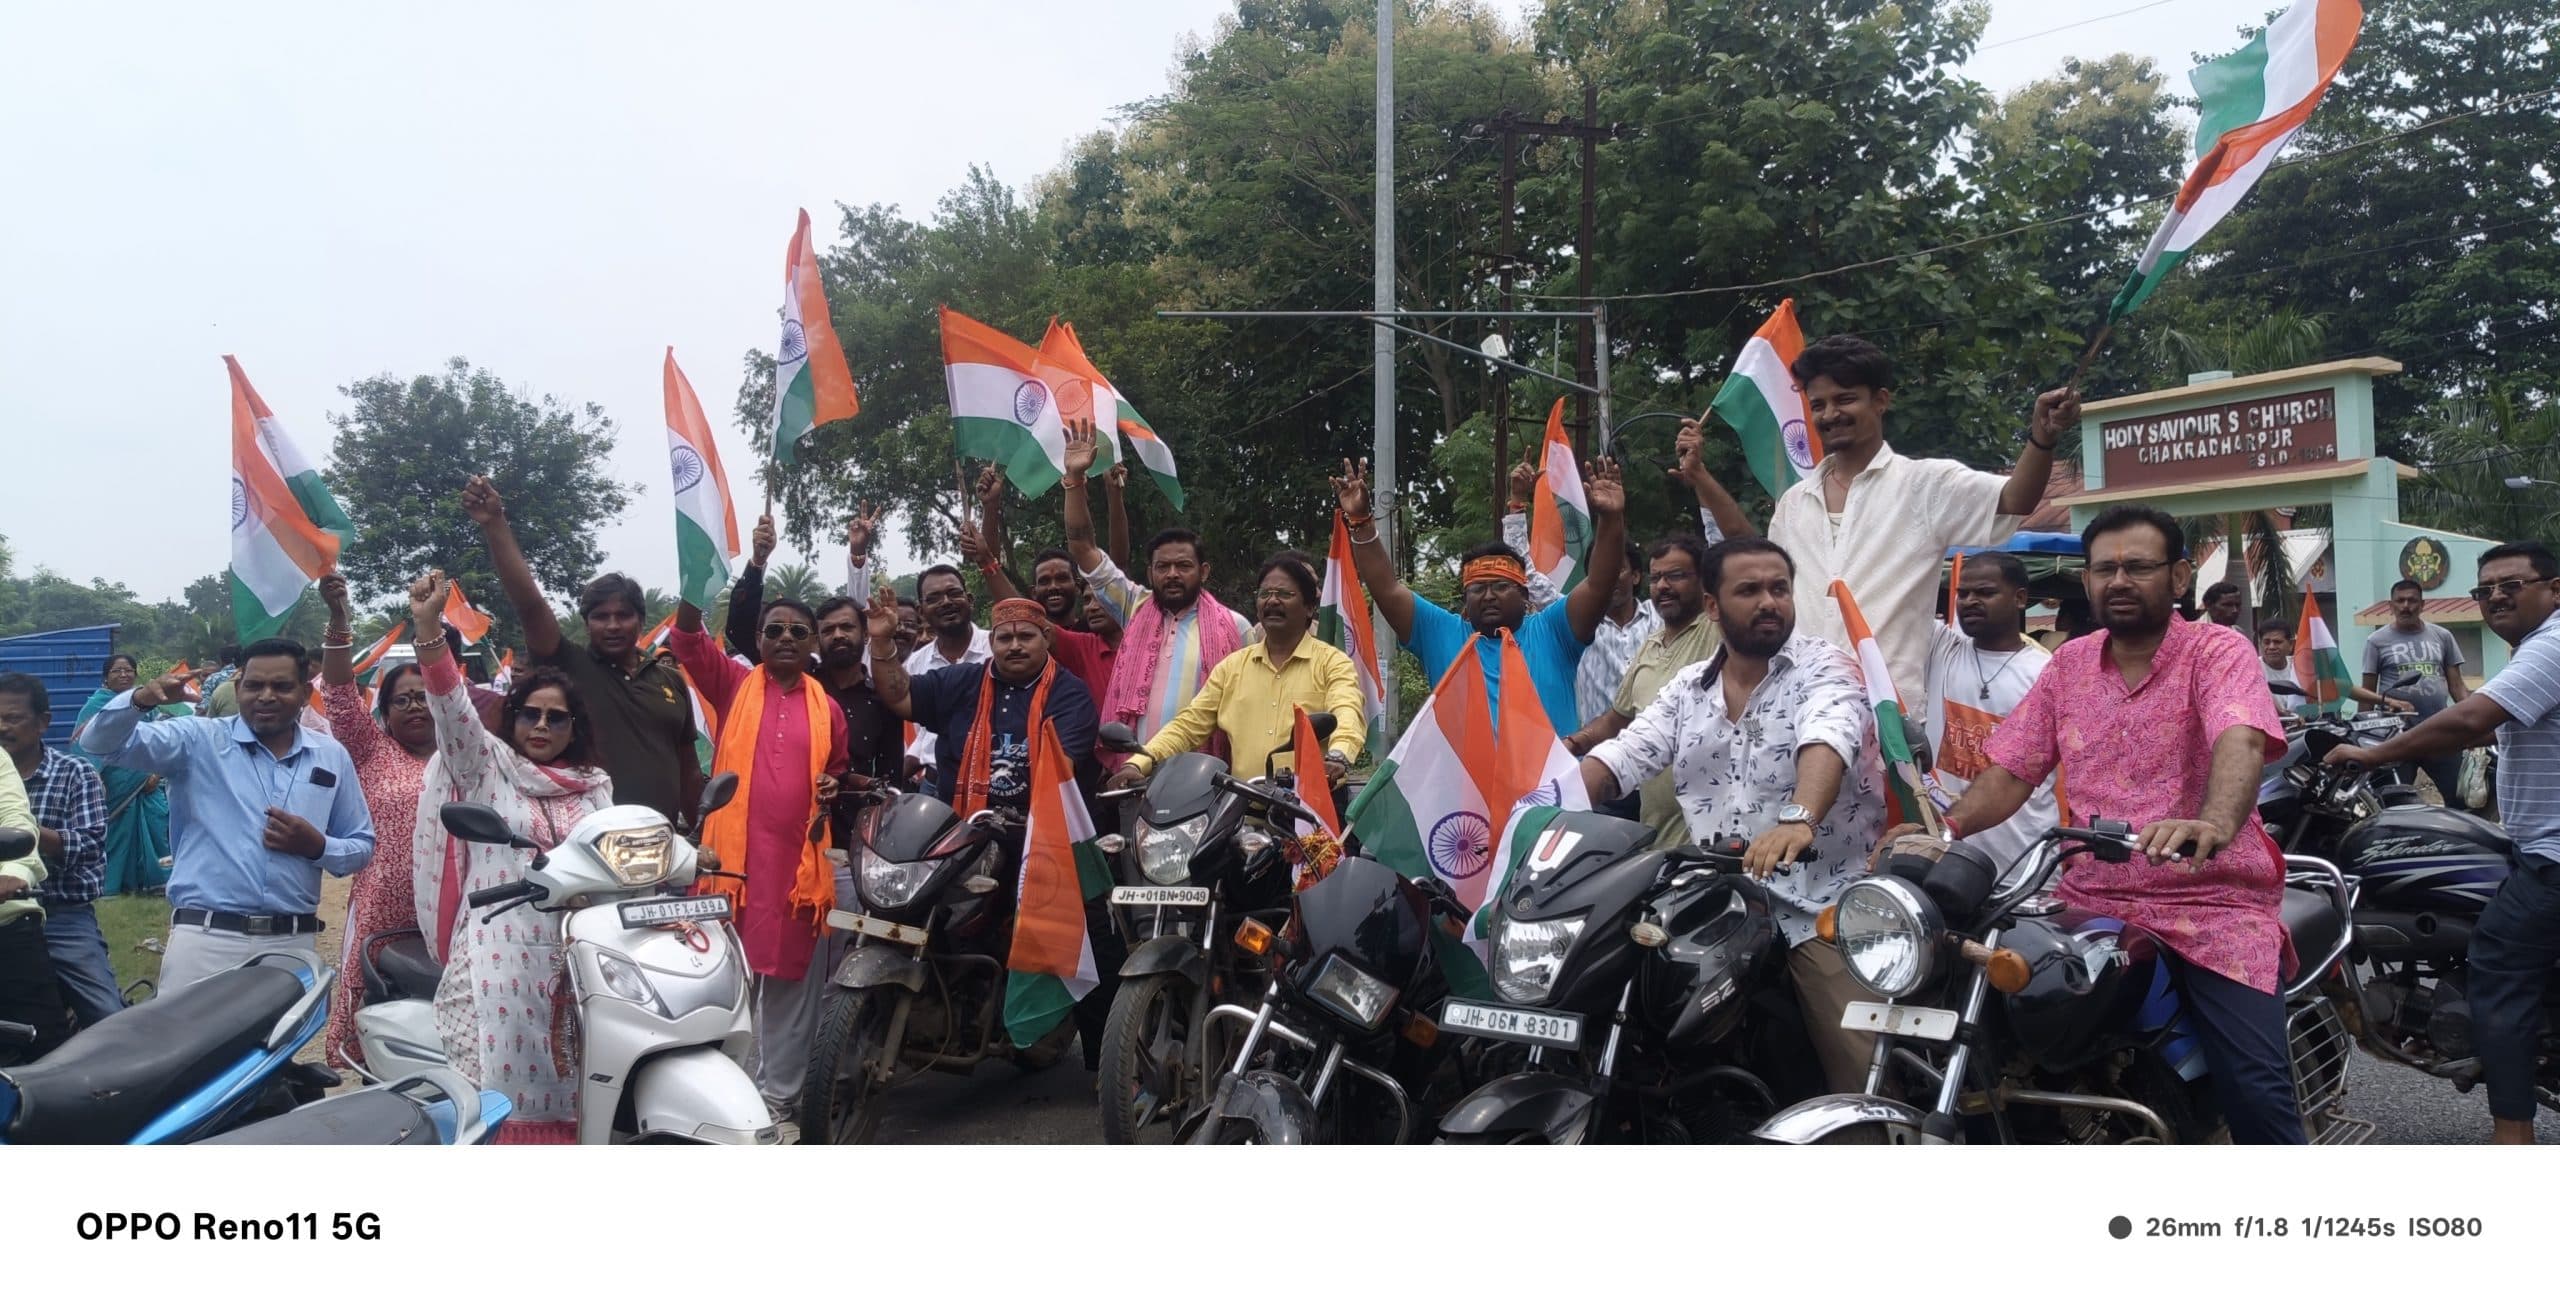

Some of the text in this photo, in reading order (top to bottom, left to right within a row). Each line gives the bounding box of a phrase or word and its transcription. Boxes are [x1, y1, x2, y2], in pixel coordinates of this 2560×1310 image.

[2104, 423, 2144, 450] HOLY
[2247, 397, 2333, 429] CHURCH
[2138, 428, 2293, 464] CHAKRADHARPUR
[2391, 640, 2442, 664] RUN
[2110, 950, 2130, 967] TVS
